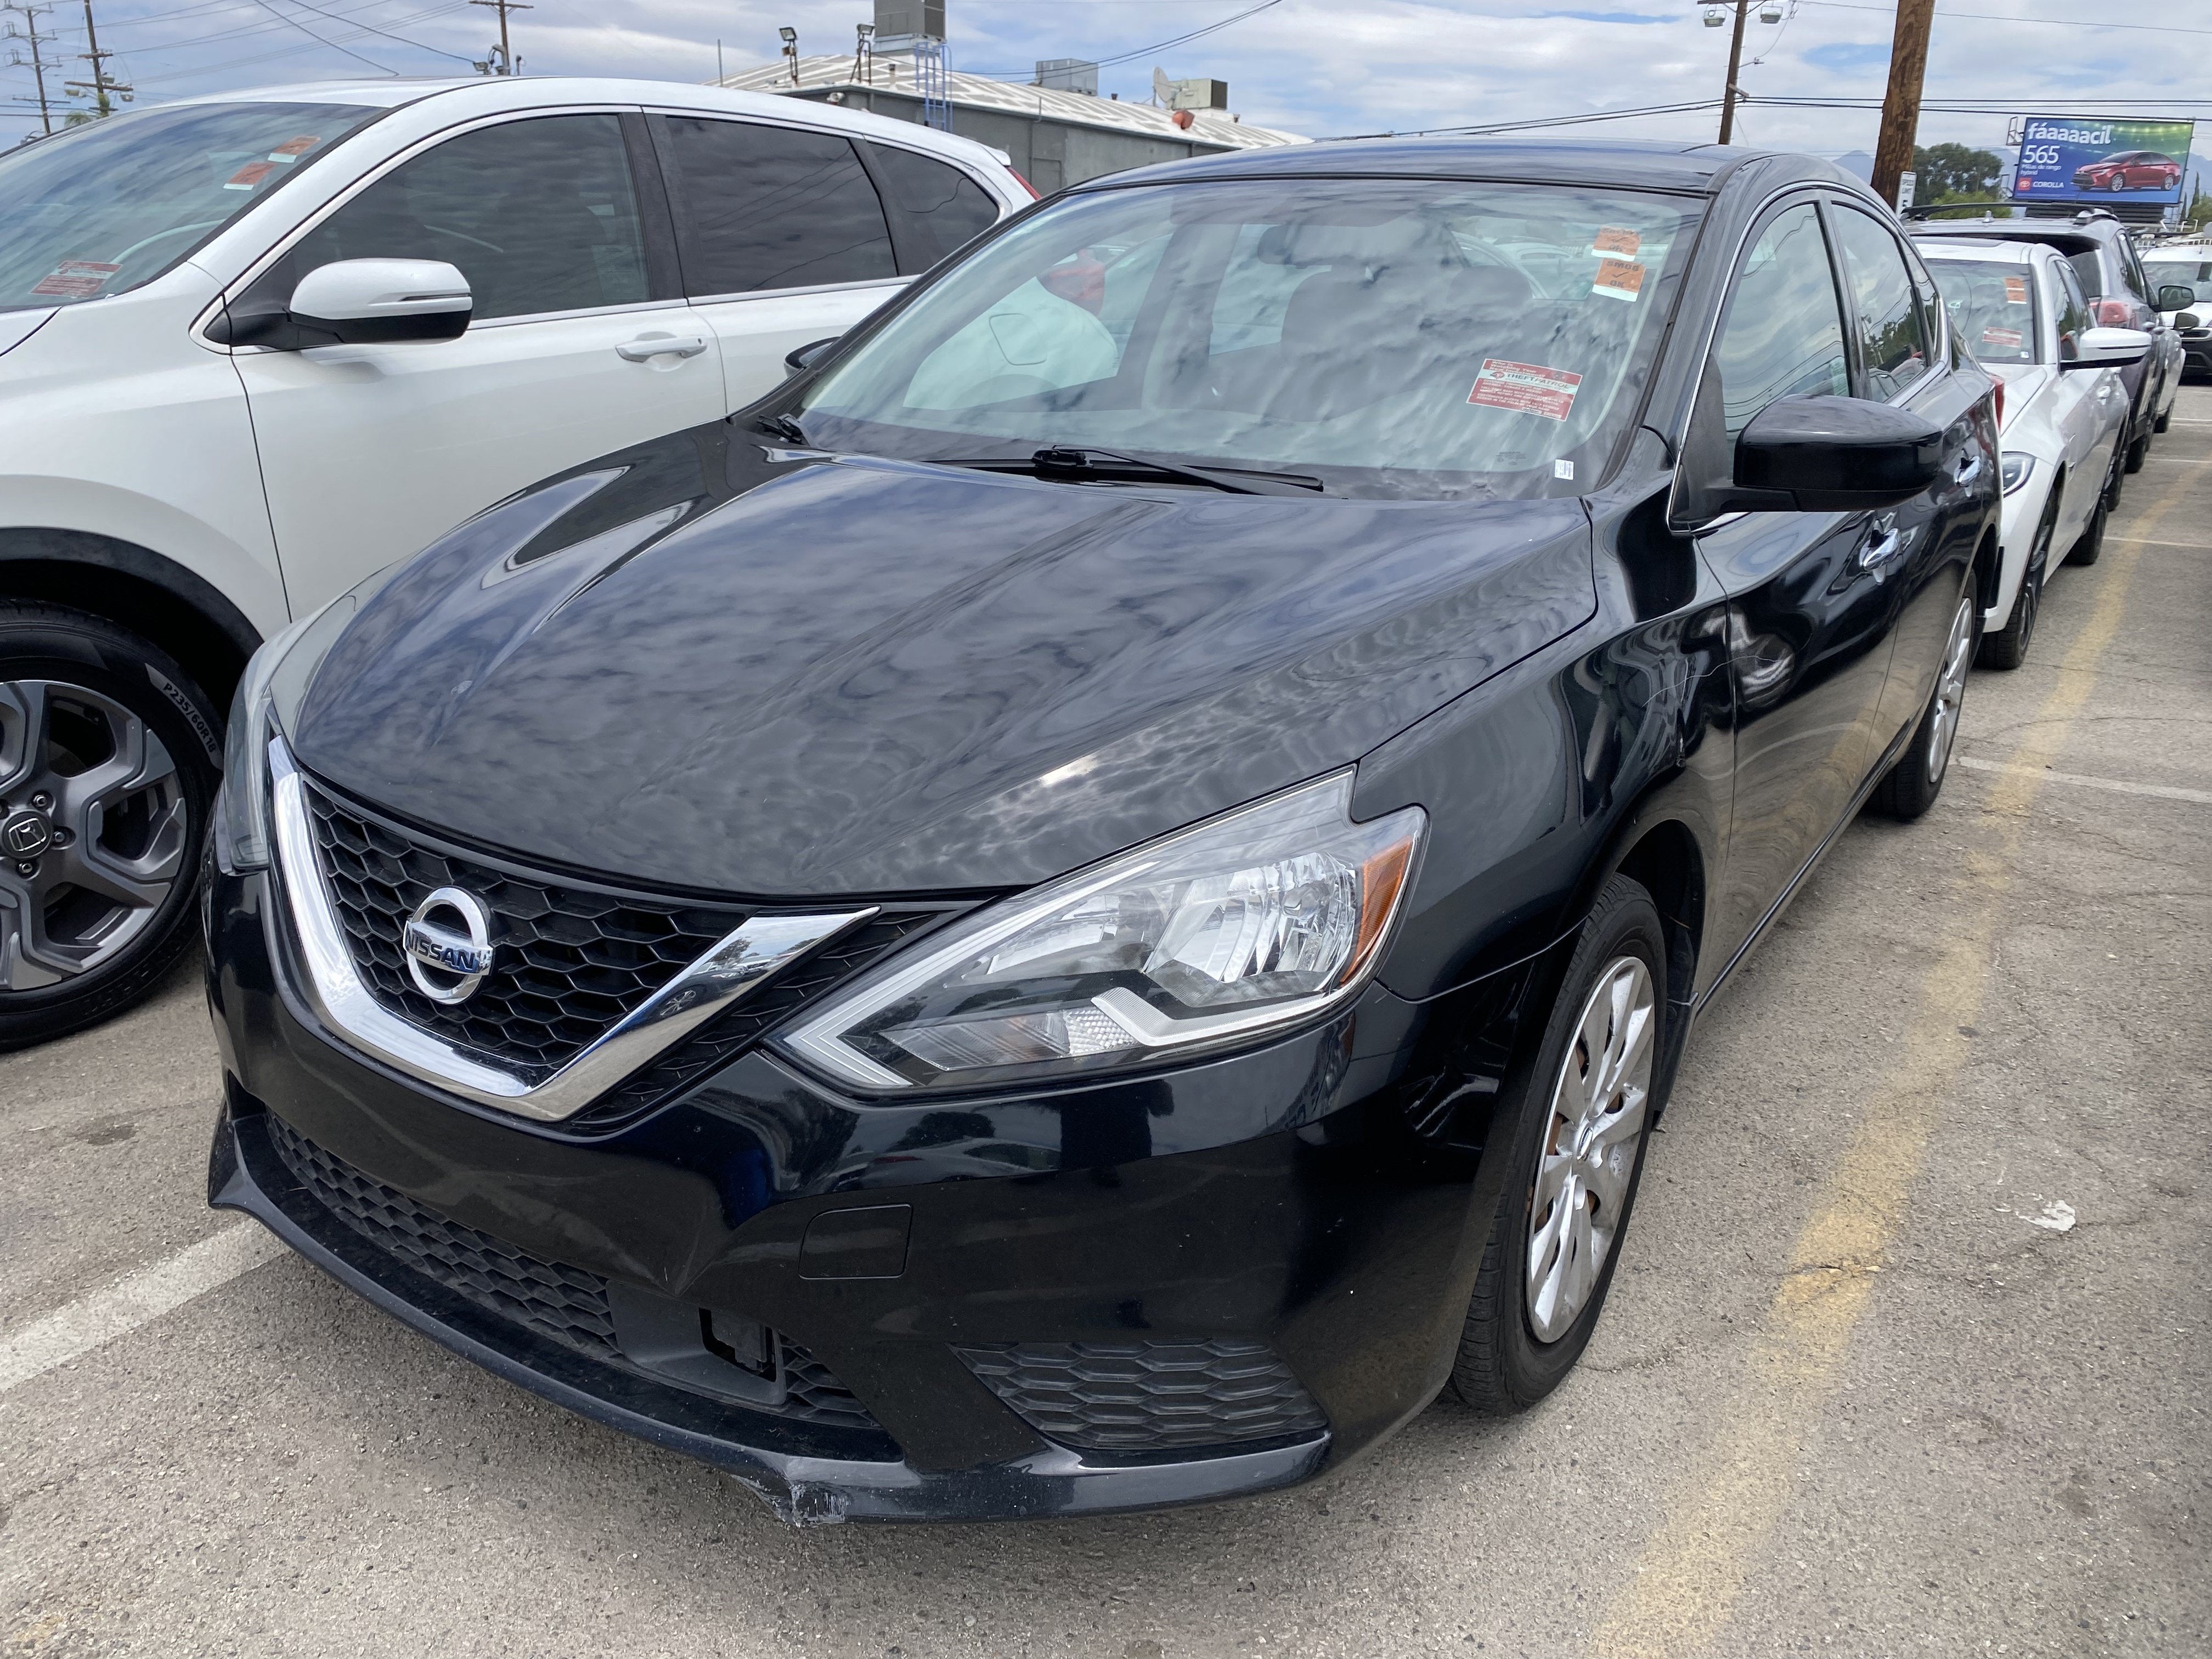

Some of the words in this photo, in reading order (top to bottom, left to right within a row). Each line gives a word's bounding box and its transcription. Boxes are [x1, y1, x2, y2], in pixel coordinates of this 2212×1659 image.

[2028, 122, 2114, 144] fáaaaacil
[2023, 145, 2061, 164] 565
[1606, 261, 1639, 272] SMOG
[1610, 280, 1624, 288] OK
[163, 682, 216, 753] P235/60R18
[405, 933, 476, 970] NISSAN
